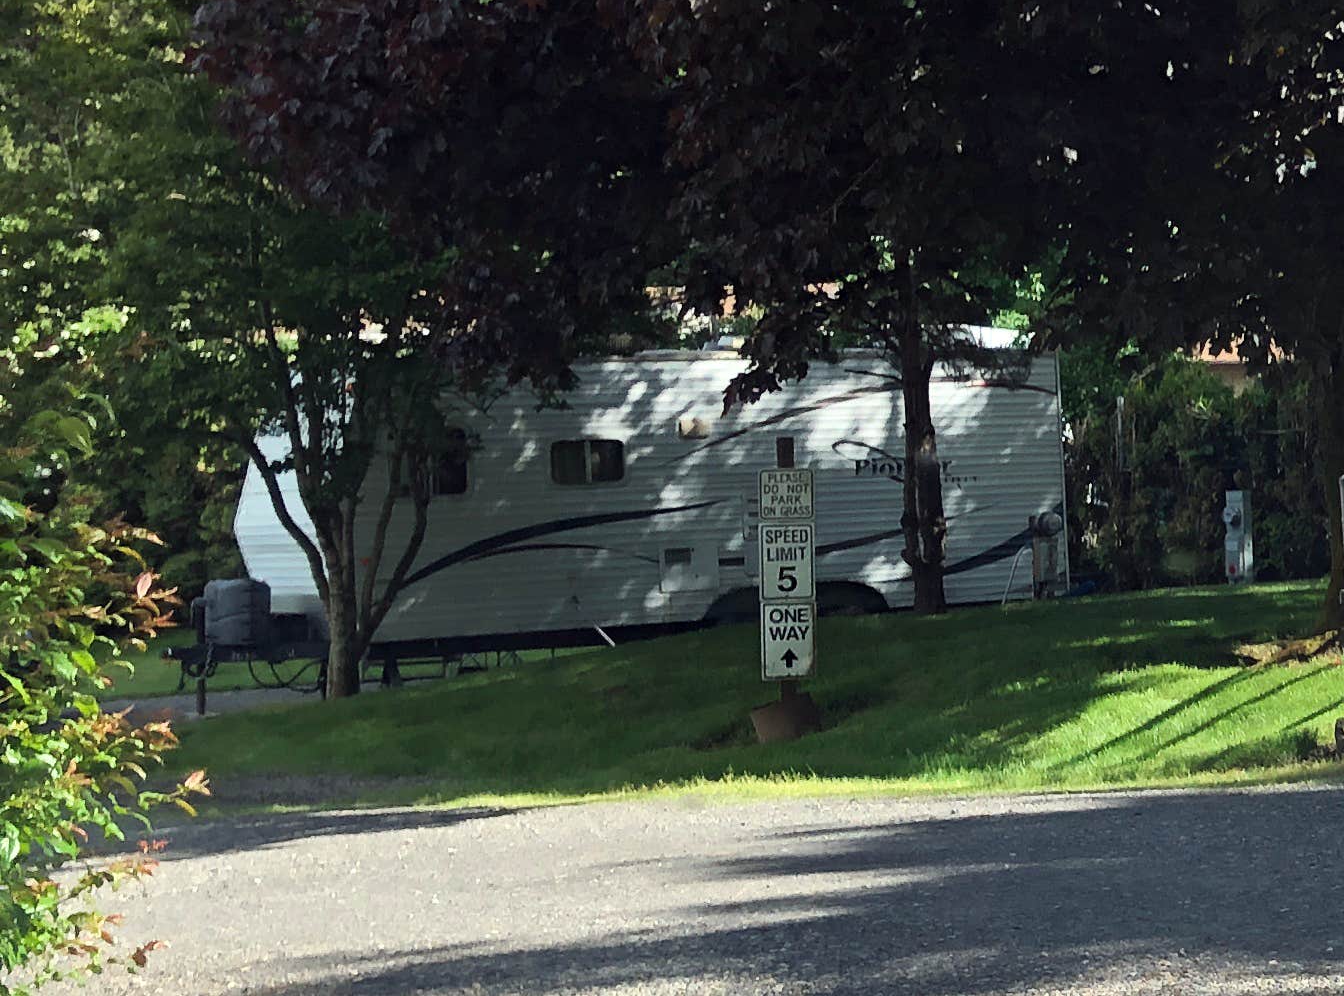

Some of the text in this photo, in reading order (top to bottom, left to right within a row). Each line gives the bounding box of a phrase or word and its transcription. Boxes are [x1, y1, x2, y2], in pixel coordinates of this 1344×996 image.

[768, 473, 809, 483] PLEASE
[763, 484, 809, 494] DO NOT
[771, 495, 801, 504] PARK
[763, 506, 810, 516] ON GRASS
[765, 529, 809, 544] SPEED
[767, 546, 806, 562] LIMIT
[777, 566, 798, 592] 5
[769, 608, 809, 623] ONE
[769, 626, 809, 641] WAY
